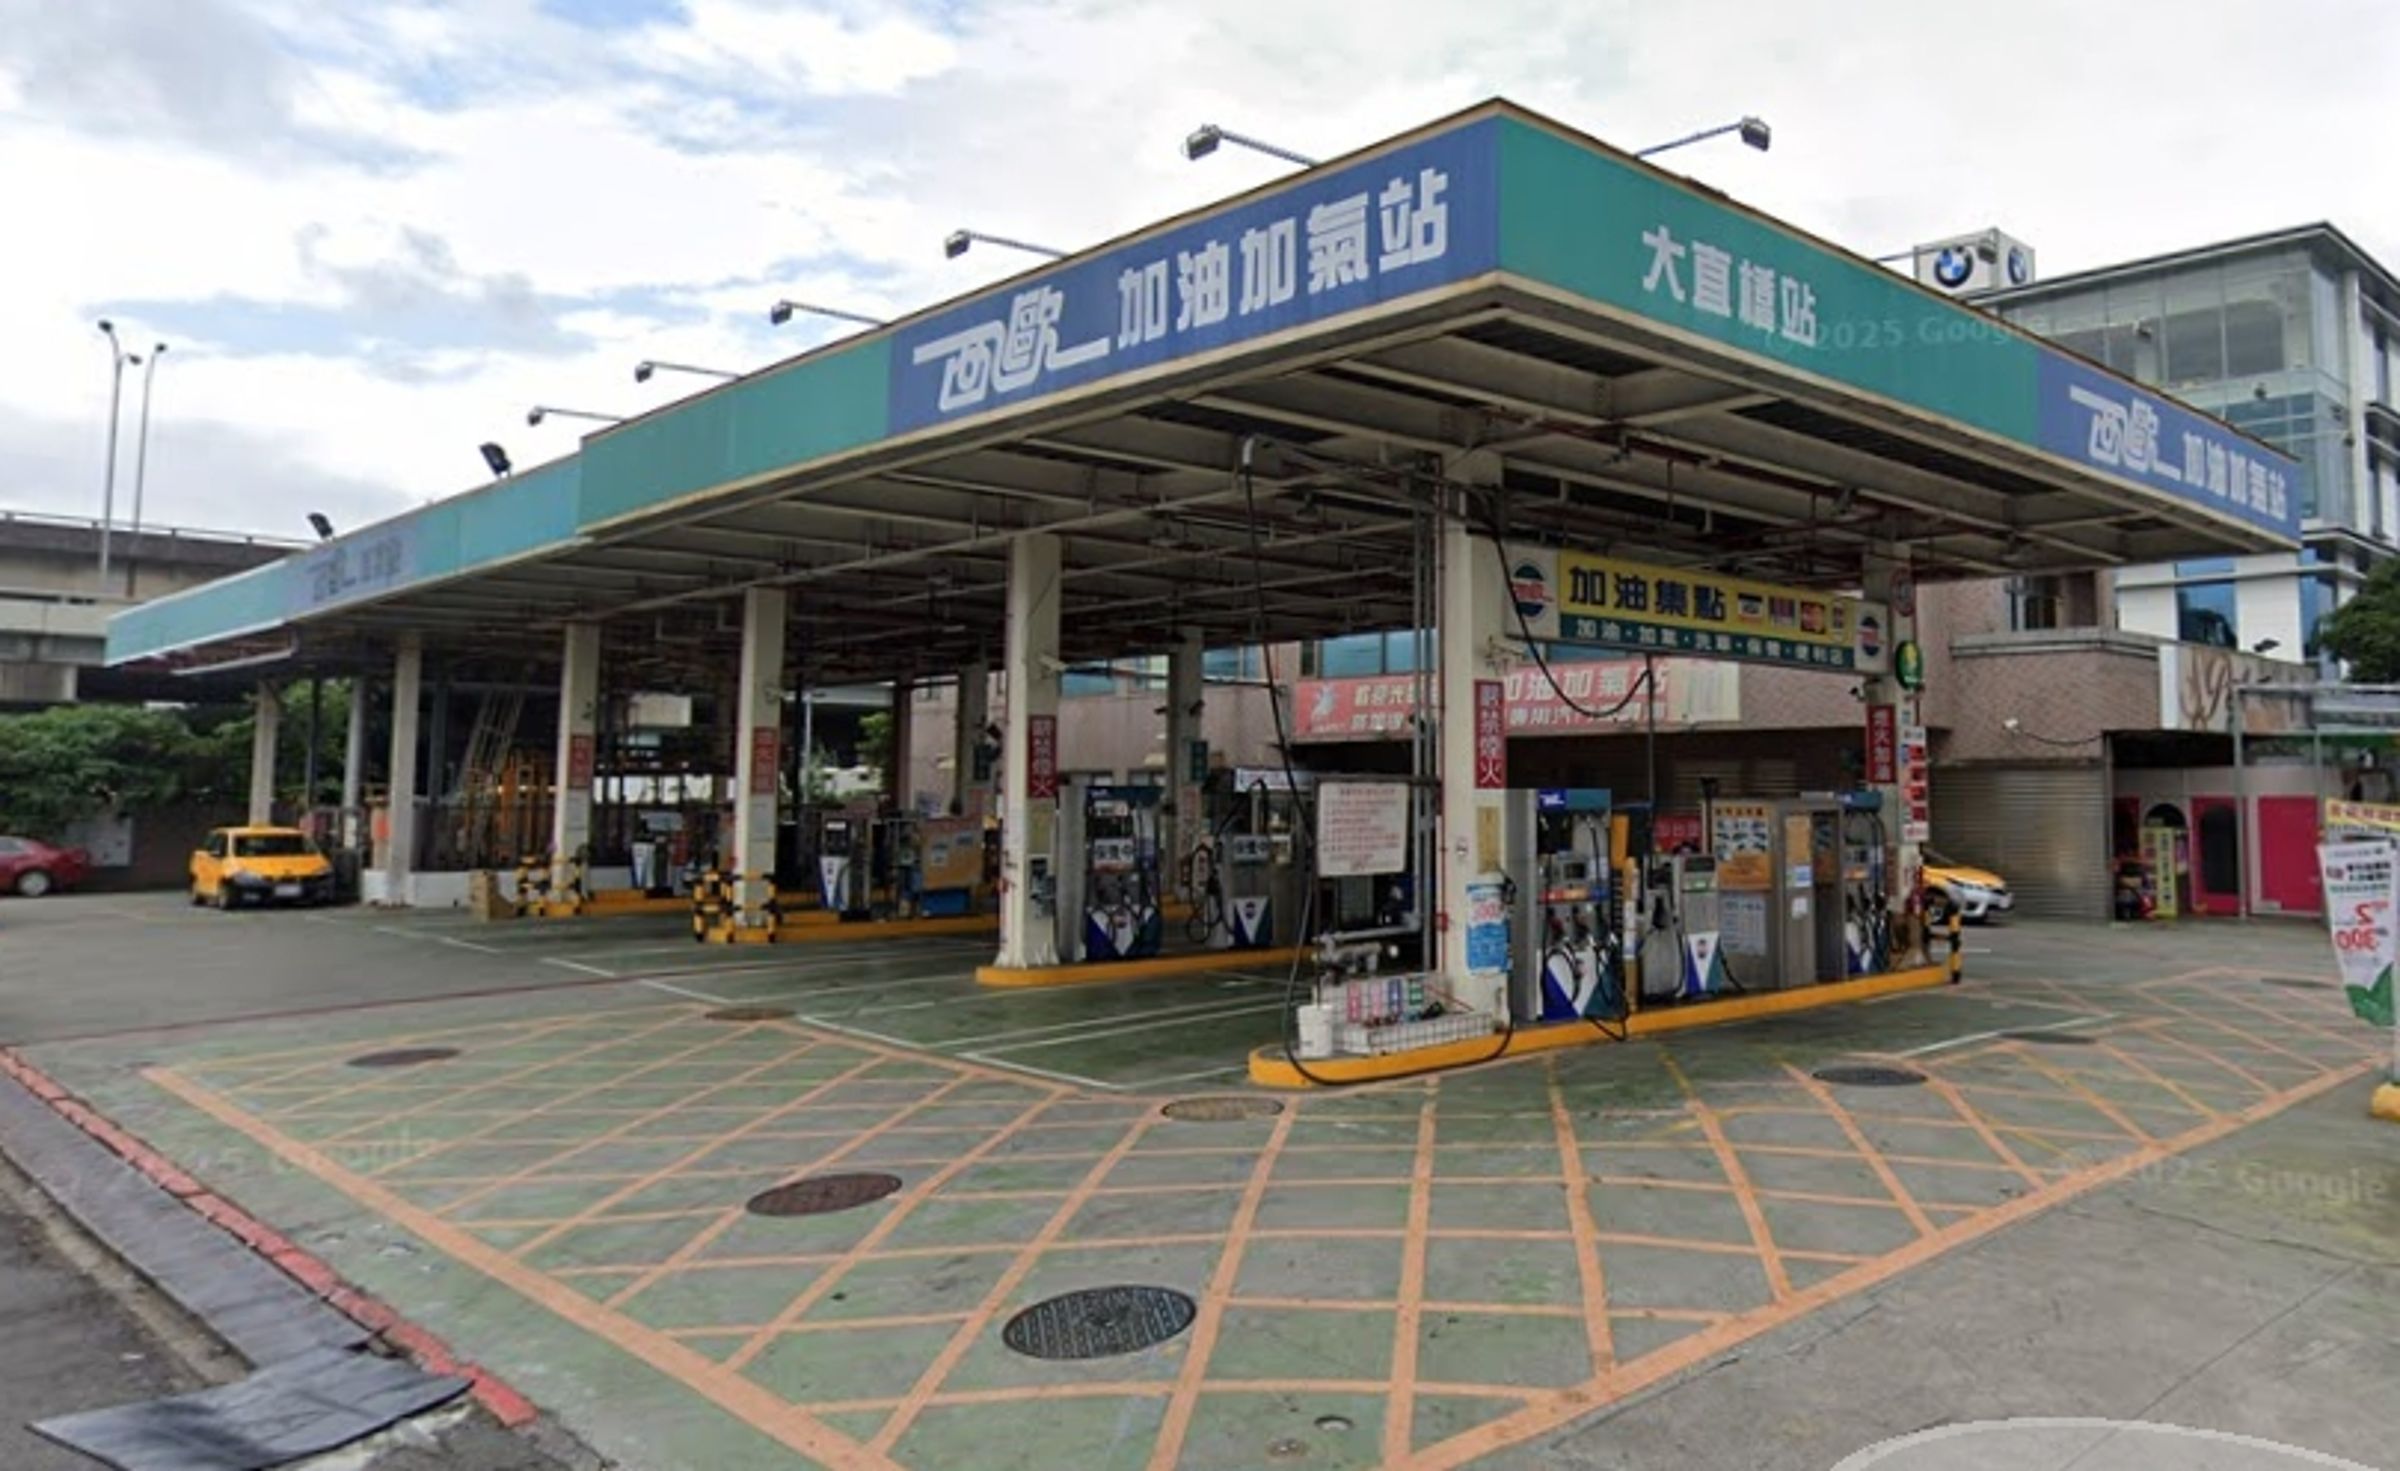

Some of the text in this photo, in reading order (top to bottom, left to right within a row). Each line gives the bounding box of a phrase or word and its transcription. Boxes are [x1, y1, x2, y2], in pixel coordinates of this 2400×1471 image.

[1641, 225, 1817, 347] 大直橋站
[1568, 565, 1727, 622] 加油集點
